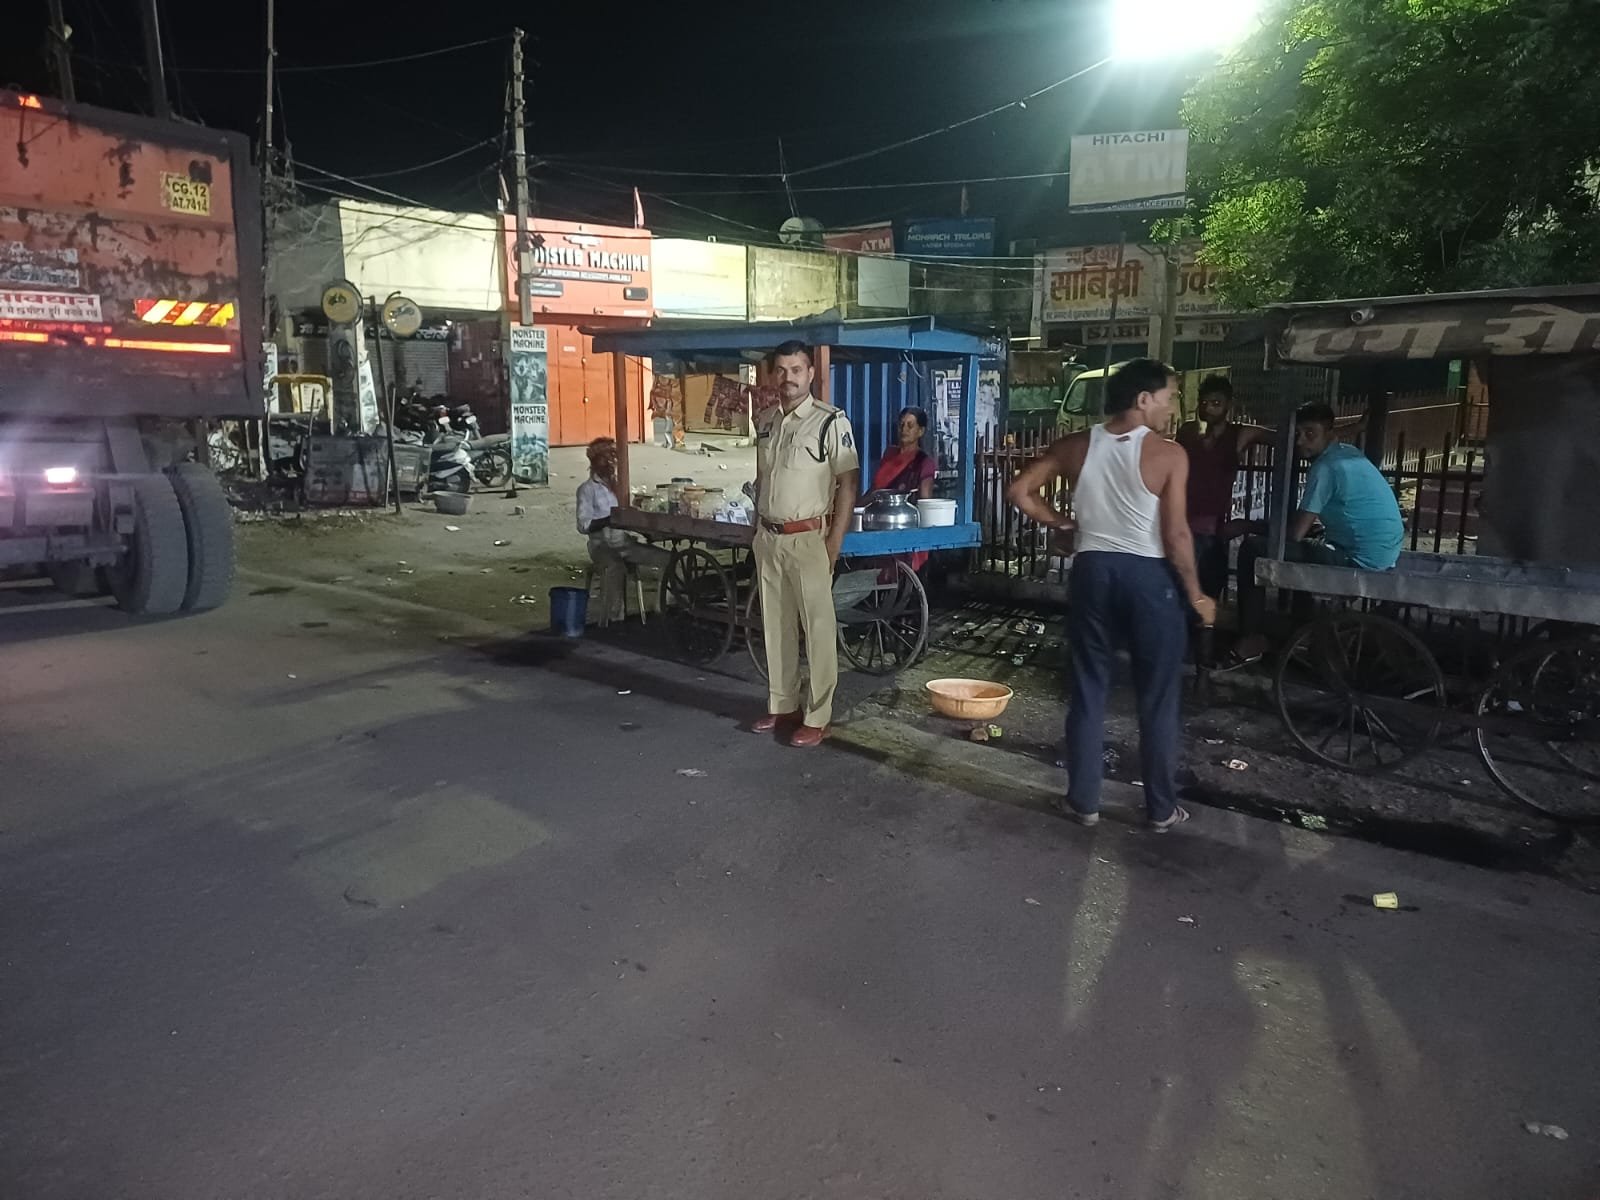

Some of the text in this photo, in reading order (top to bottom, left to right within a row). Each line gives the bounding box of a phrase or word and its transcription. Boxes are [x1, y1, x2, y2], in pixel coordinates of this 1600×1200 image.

[1093, 132, 1165, 146] HITACHI
[1074, 149, 1182, 185] ATM
[861, 238, 890, 251] ATM
[534, 246, 649, 272] NSTER MACHINE
[512, 329, 545, 340] MONSTER
[513, 339, 545, 349] MACHINE
[513, 405, 546, 416] MONSTER
[514, 414, 546, 424] MACHINE
